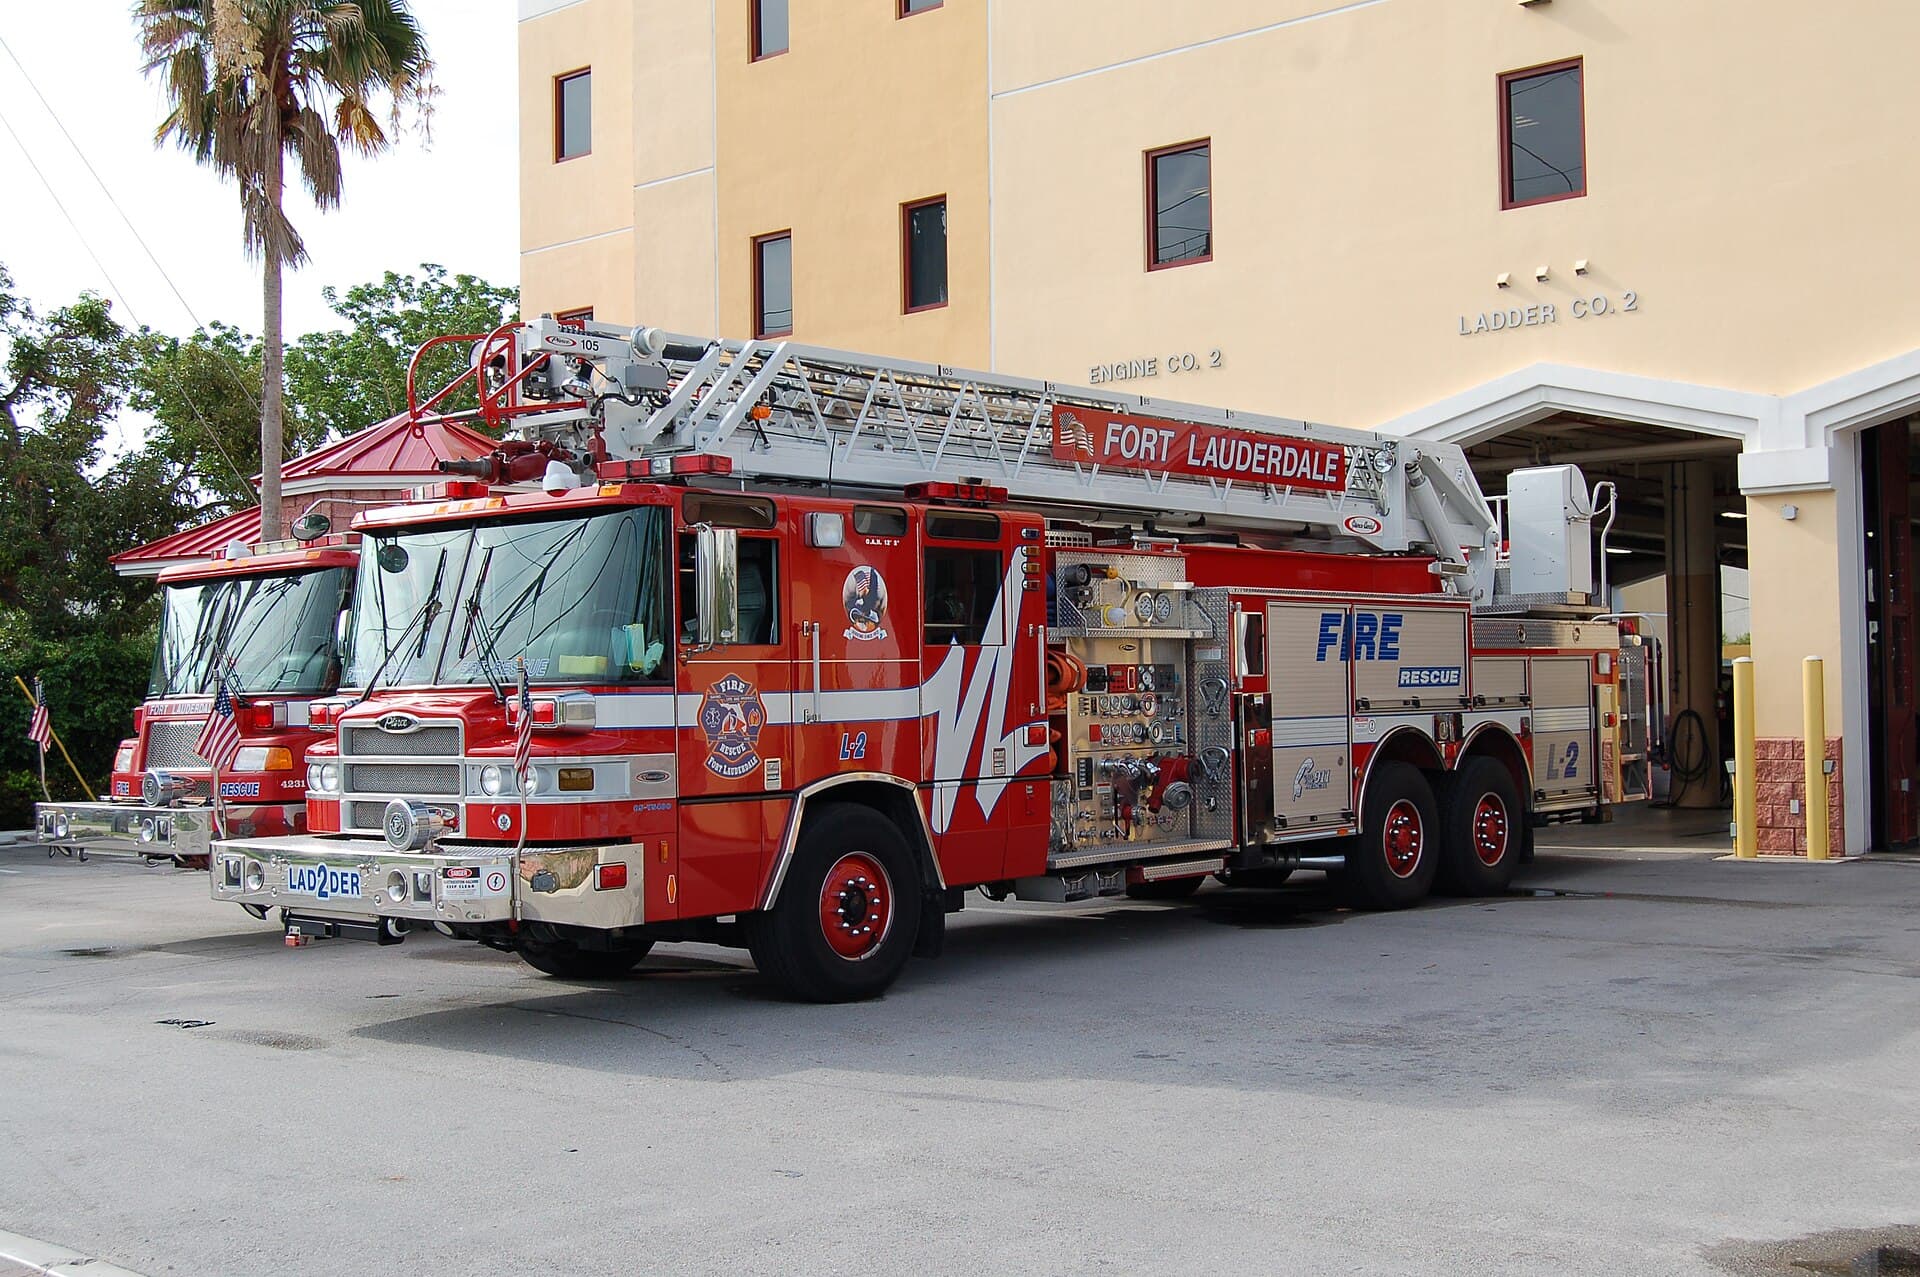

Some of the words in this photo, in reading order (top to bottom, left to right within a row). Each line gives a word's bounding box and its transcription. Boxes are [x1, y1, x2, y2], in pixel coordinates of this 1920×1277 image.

[1459, 303, 1556, 335] LADDER
[1571, 295, 1615, 319] CO.
[1623, 289, 1638, 312] 2
[580, 340, 599, 352] 105
[1089, 357, 1158, 385] ENGINE
[1167, 352, 1201, 373] CO.
[1209, 349, 1222, 368] 2
[1103, 422, 1176, 463] FORT
[1187, 433, 1340, 483] LAUDERDALE
[1316, 612, 1403, 662] FIRE
[1399, 670, 1459, 684] RESCUE
[719, 679, 746, 693] FIRE
[720, 743, 747, 756] RESCUE
[707, 756, 723, 773] FORT
[723, 756, 759, 776] LAUDERDALE
[221, 782, 260, 796] RESCUE
